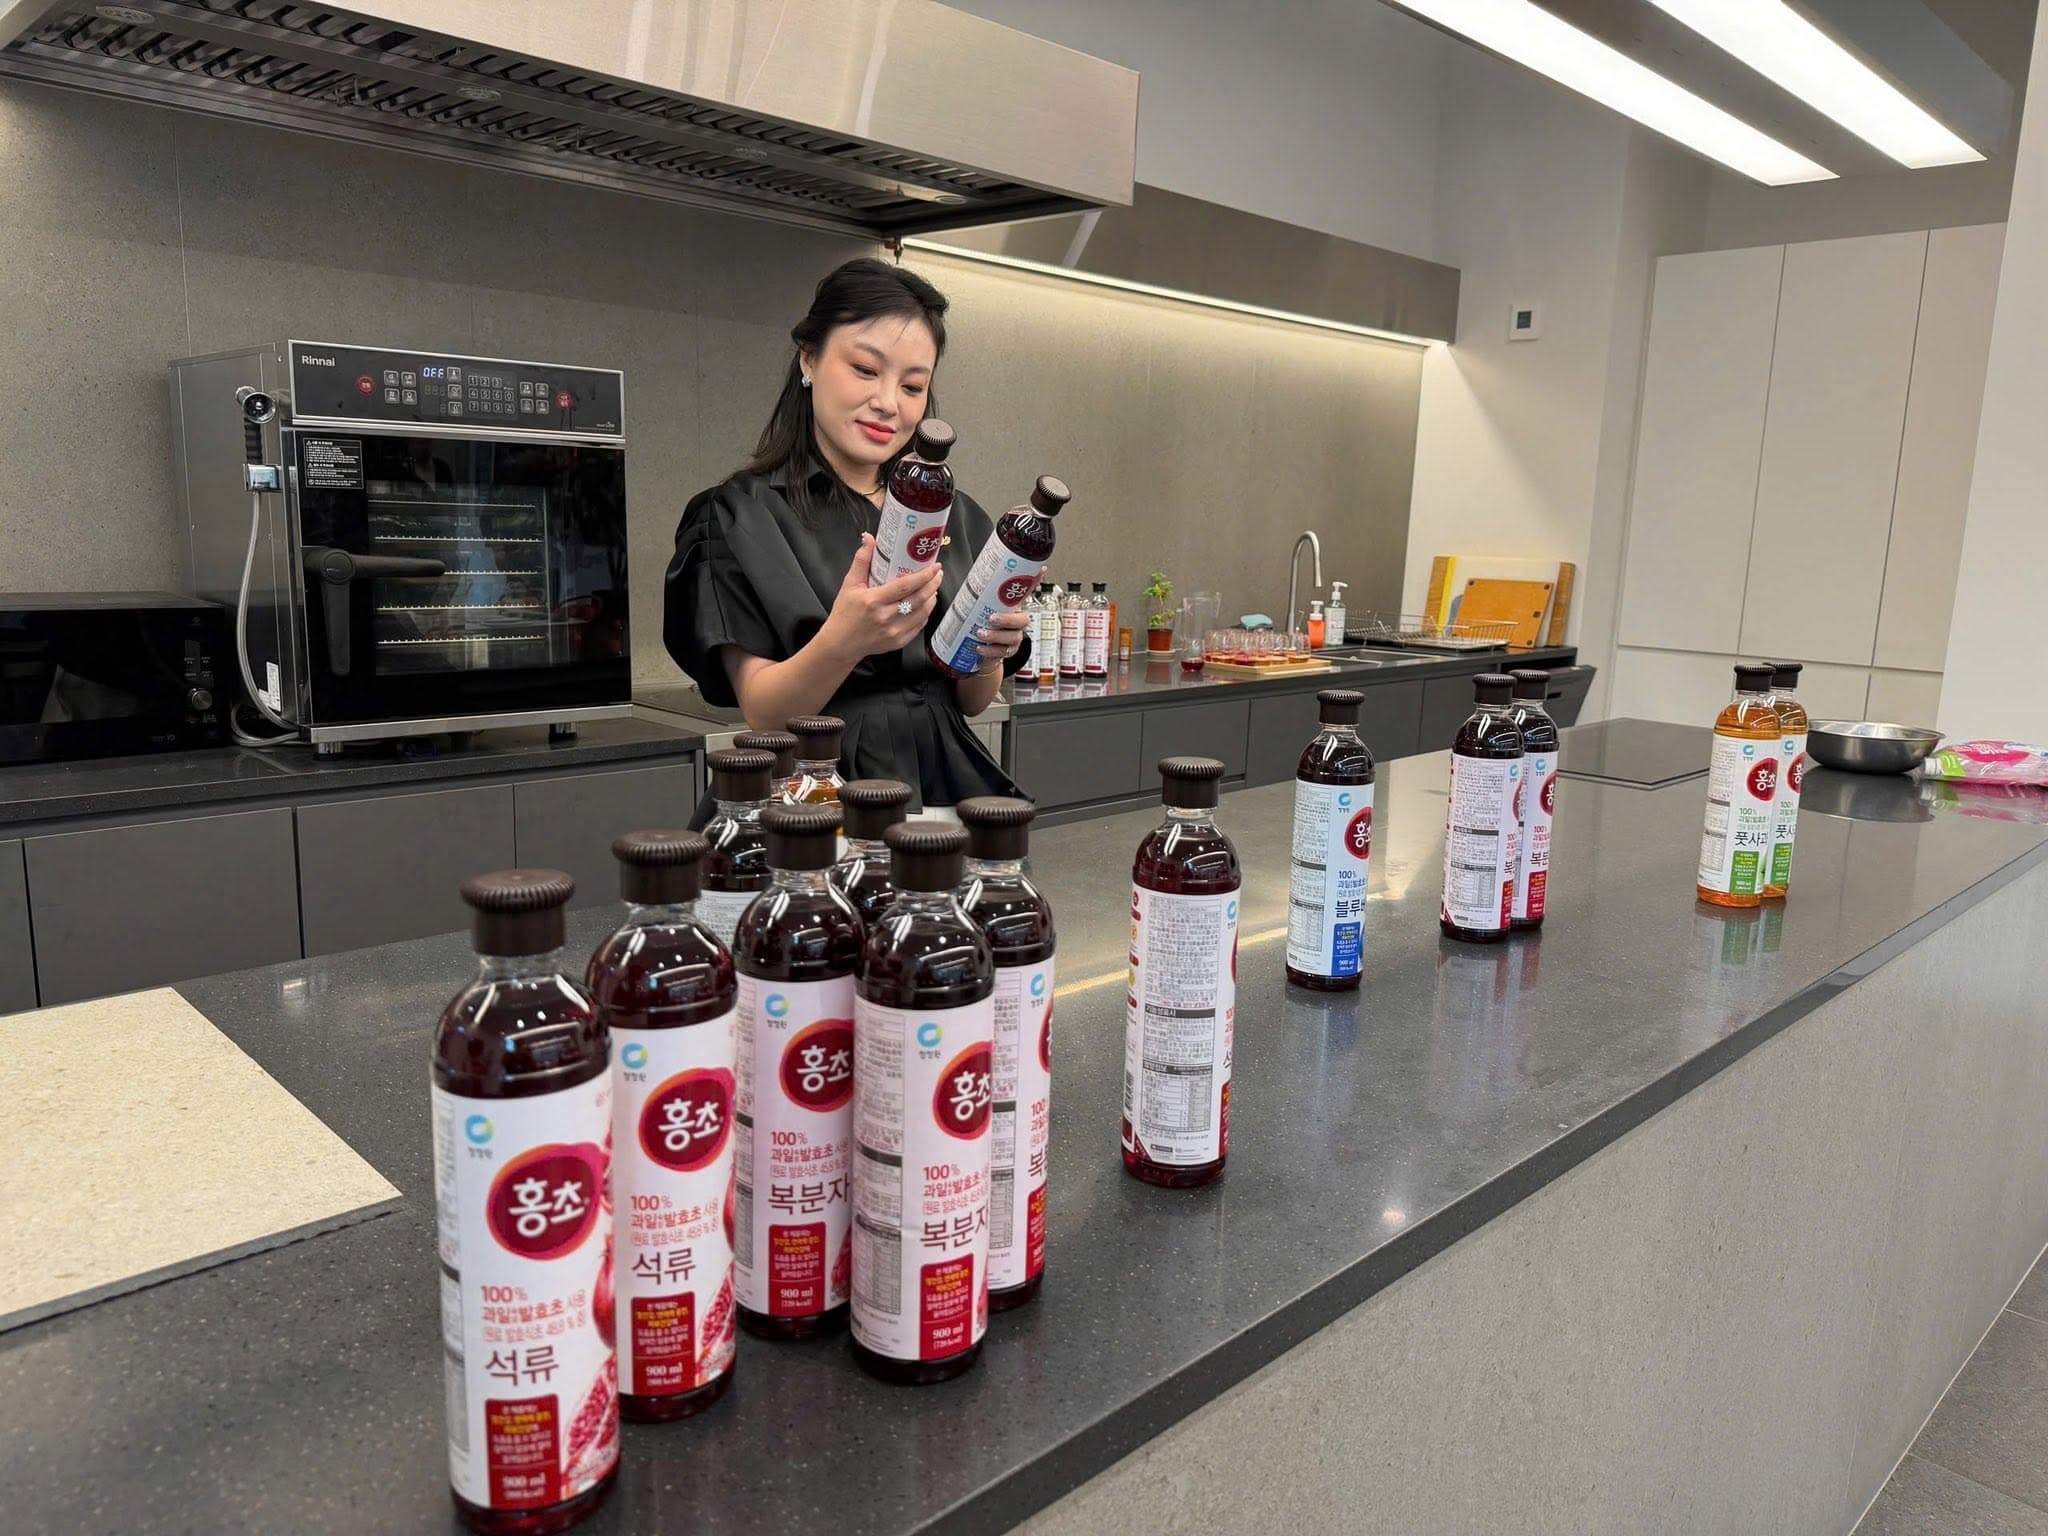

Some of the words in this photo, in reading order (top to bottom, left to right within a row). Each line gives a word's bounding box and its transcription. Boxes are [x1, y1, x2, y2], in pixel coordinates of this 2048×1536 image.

[302, 355, 335, 367] Rinnai
[423, 367, 444, 378] OFF
[916, 536, 939, 555] 홍초
[796, 1044, 850, 1092] 홍초
[949, 1070, 991, 1121] 홍초
[658, 1098, 721, 1151] 홍초
[771, 1131, 808, 1145] 100%
[923, 1163, 961, 1180] 100%
[631, 1195, 673, 1211] 100%
[768, 1173, 850, 1215] 복분자
[508, 1177, 585, 1238] 홍초
[632, 1247, 696, 1286] 석류
[480, 1285, 528, 1303] 100%
[780, 1288, 799, 1298] 900
[801, 1285, 813, 1297] ml
[932, 1327, 951, 1340] 900
[952, 1321, 964, 1335] ml
[485, 1344, 560, 1387] 석류
[645, 1365, 666, 1377] 900
[668, 1361, 683, 1375] ml
